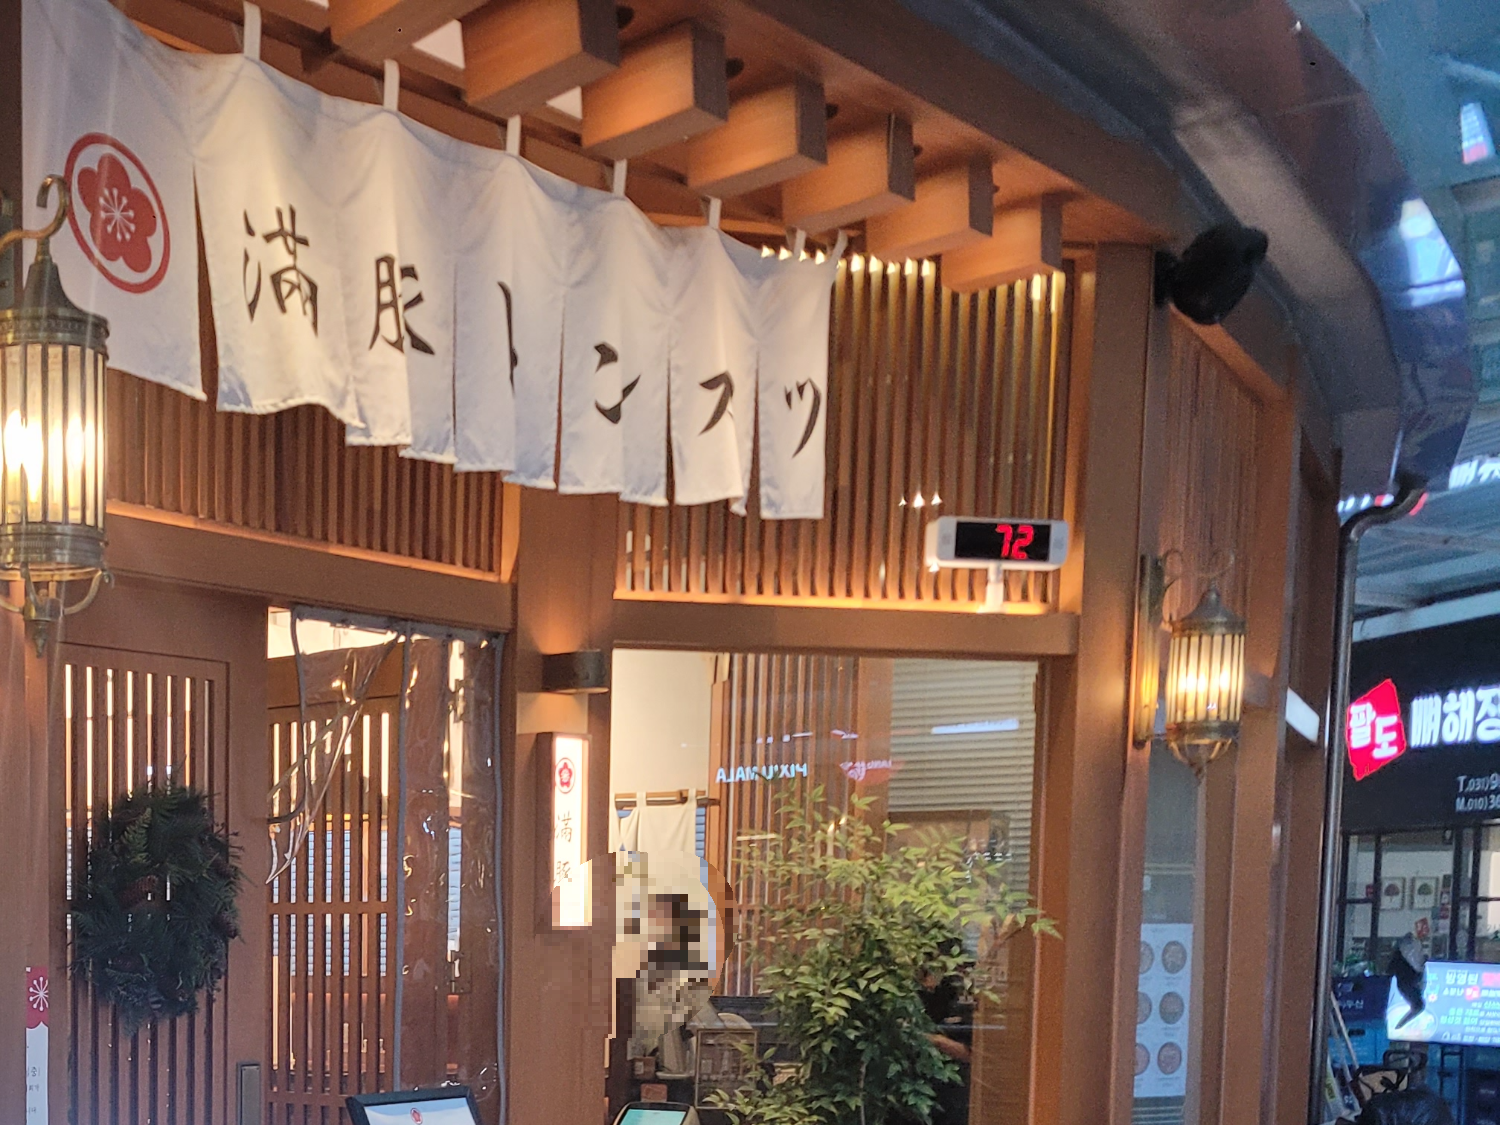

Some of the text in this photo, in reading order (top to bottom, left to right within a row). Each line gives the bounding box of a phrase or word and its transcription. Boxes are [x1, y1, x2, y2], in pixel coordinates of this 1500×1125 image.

[995, 523, 1034, 559] 72
[1349, 702, 1398, 759] 팔도
[1457, 772, 1500, 793] T.031)9
